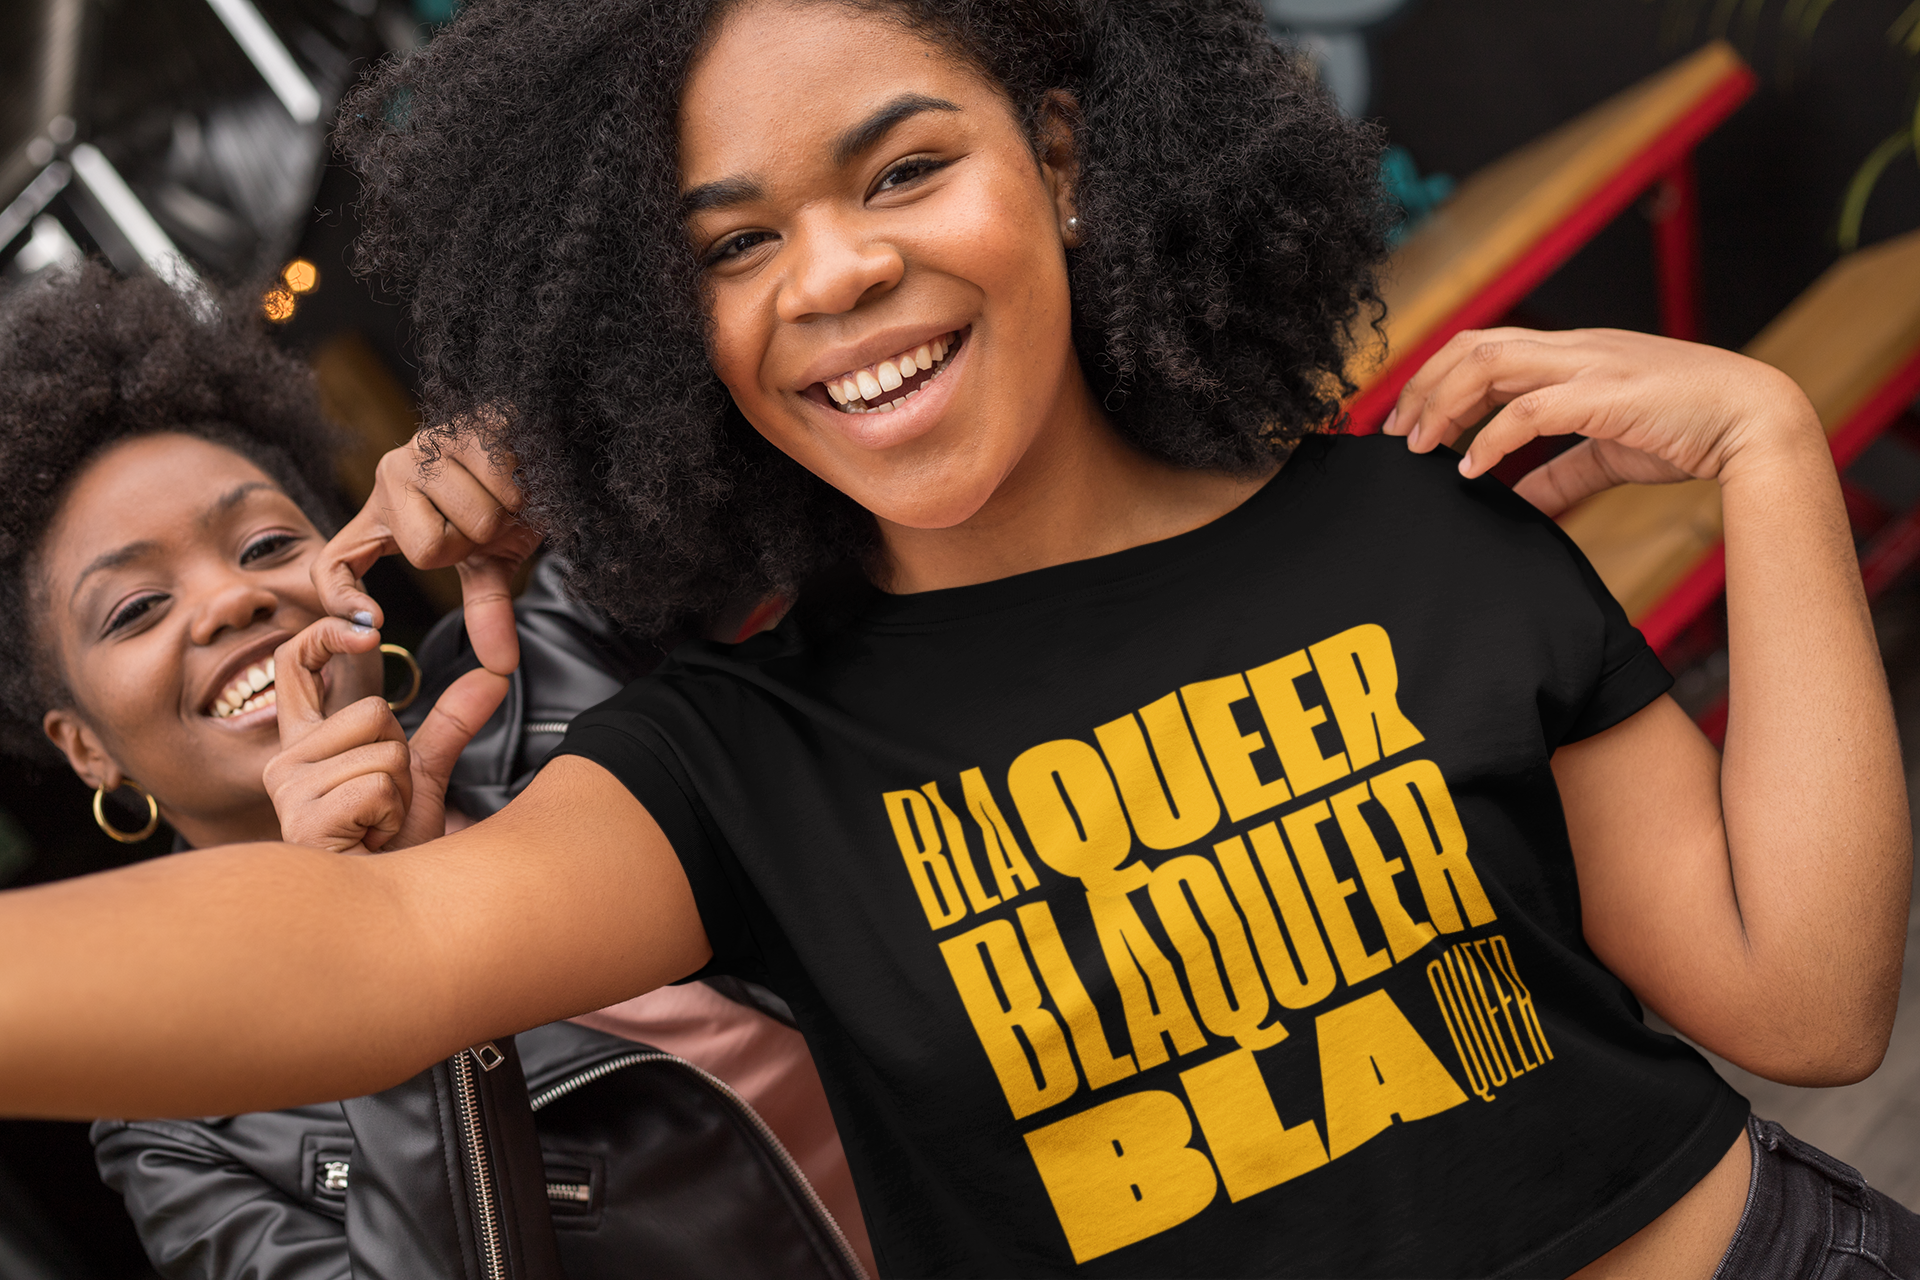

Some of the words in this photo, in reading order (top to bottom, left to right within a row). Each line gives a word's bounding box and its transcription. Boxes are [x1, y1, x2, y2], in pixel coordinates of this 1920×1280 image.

[882, 623, 1426, 931] BLAQUEER
[938, 759, 1498, 1121] BLAQUEER
[1023, 935, 1554, 1265] BLAQUEER
